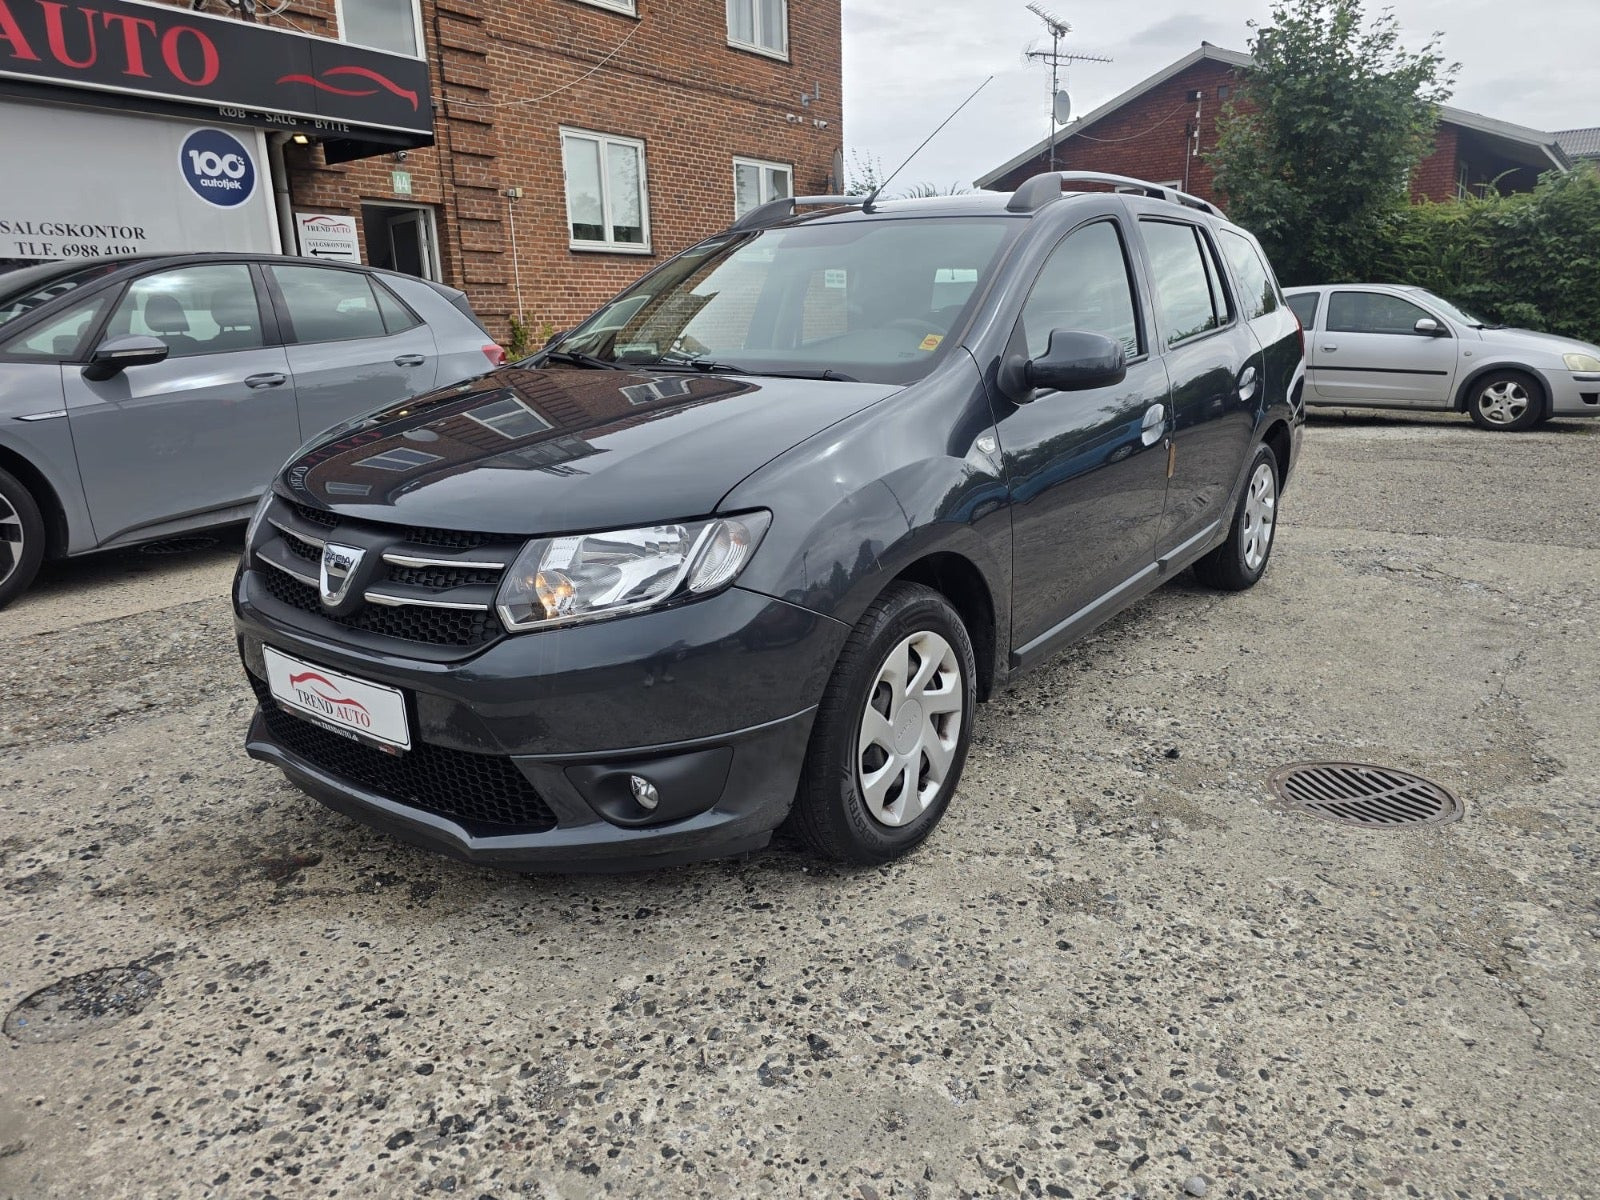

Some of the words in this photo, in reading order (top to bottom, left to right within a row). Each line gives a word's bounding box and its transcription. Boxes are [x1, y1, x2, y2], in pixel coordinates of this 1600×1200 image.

[0, 0, 219, 87] AUTO
[218, 106, 247, 119] KØB
[265, 113, 297, 126] SALG
[200, 177, 243, 191] autotjek
[396, 175, 408, 191] 44
[0, 220, 146, 240] SALGSKONTOR
[307, 225, 331, 233] TREND
[14, 241, 57, 256] TLF.
[62, 243, 100, 257] 6988
[325, 551, 351, 564] DACIA
[296, 688, 334, 715] TREND
[336, 706, 371, 728] AUTO
